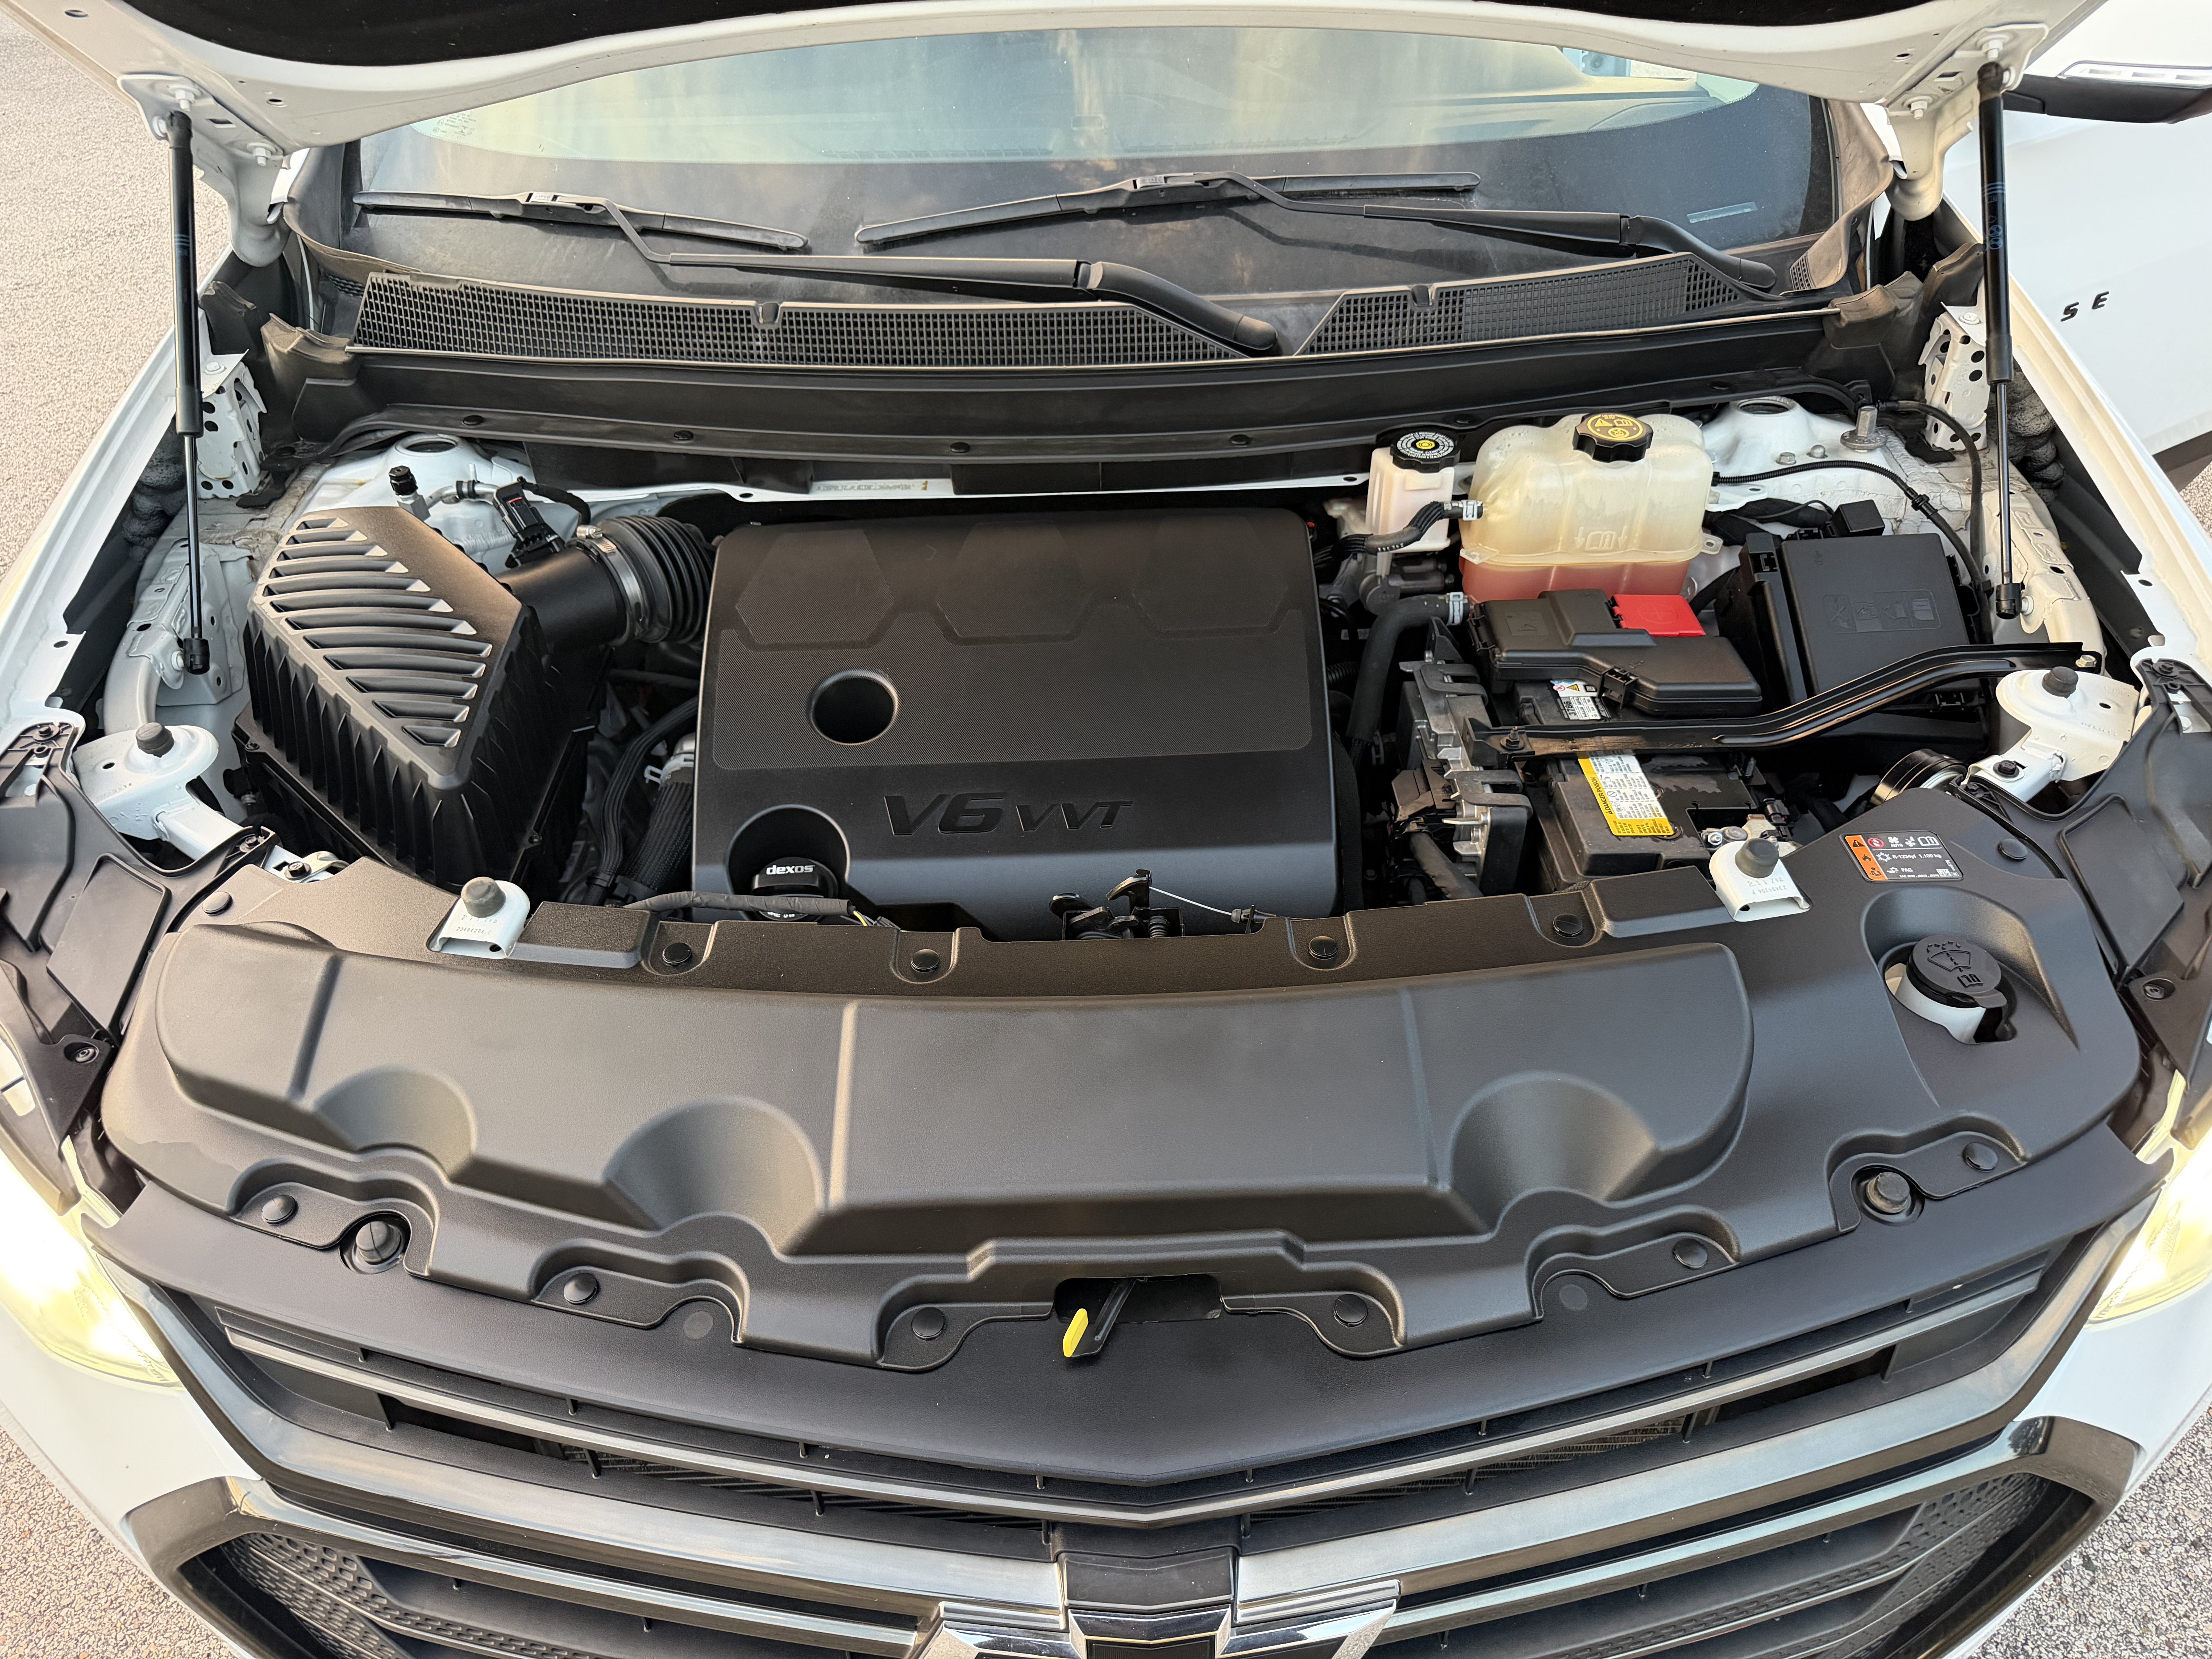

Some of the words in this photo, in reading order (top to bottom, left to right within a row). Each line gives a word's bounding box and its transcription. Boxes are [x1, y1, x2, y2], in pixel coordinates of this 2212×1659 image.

[1590, 777, 1602, 792] POISON
[1598, 792, 1609, 811] DANGER
[884, 792, 1006, 836] V6
[1016, 800, 1134, 831] VVT
[766, 865, 814, 875] dexos
